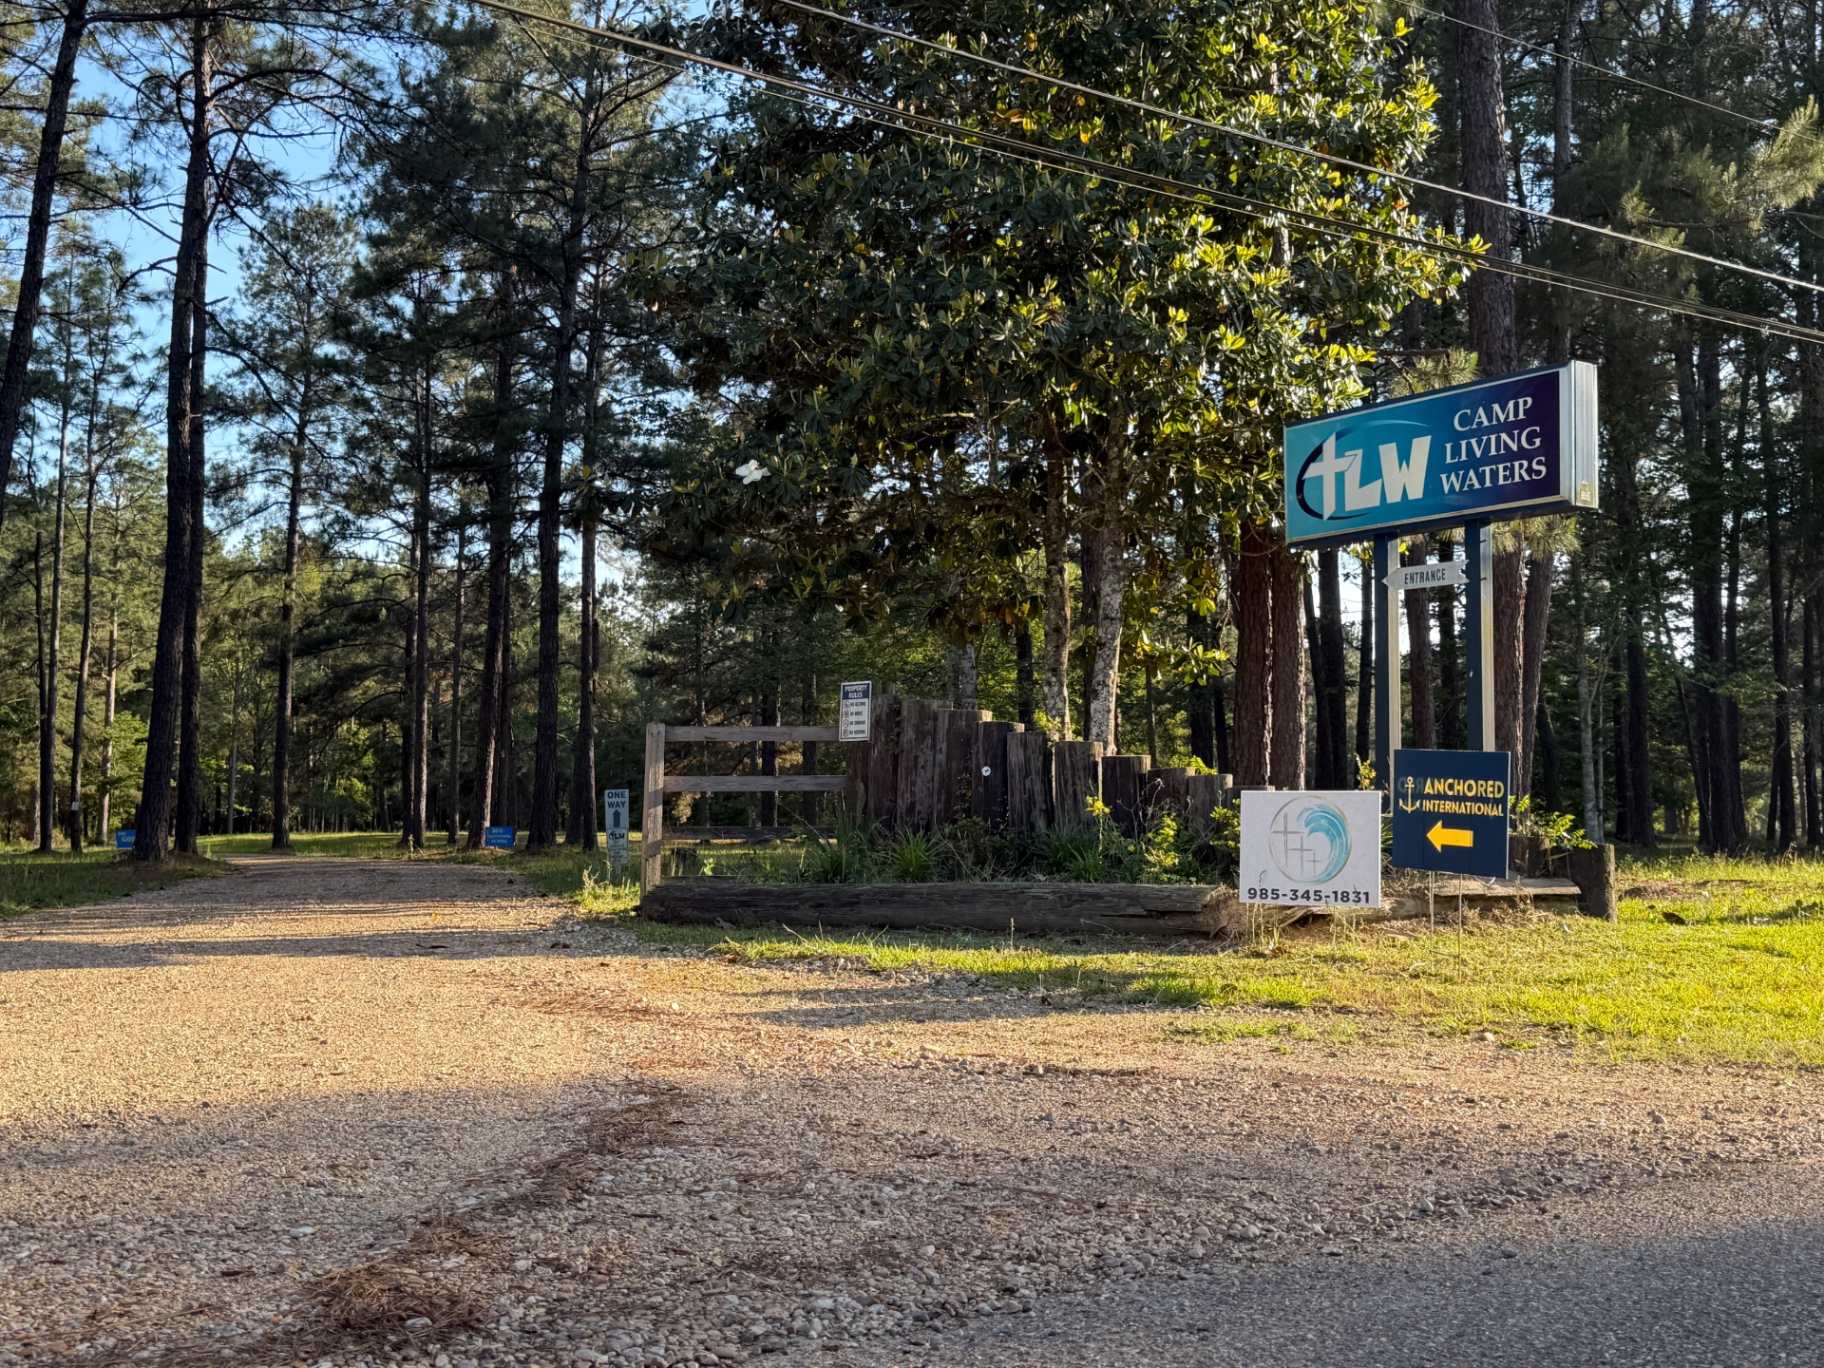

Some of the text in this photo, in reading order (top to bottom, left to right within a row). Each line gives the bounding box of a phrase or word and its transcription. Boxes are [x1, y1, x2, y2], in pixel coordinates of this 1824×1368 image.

[1453, 396, 1533, 432] CAMP
[1444, 426, 1542, 464] LIVING
[1440, 456, 1547, 494] WATERS
[1404, 568, 1447, 584] ENTRANCE
[607, 791, 626, 799] ONE
[1424, 777, 1504, 798] ANCHORED
[1423, 799, 1504, 816] INTERNATIONAL
[1247, 887, 1370, 904] 985-345-1831
